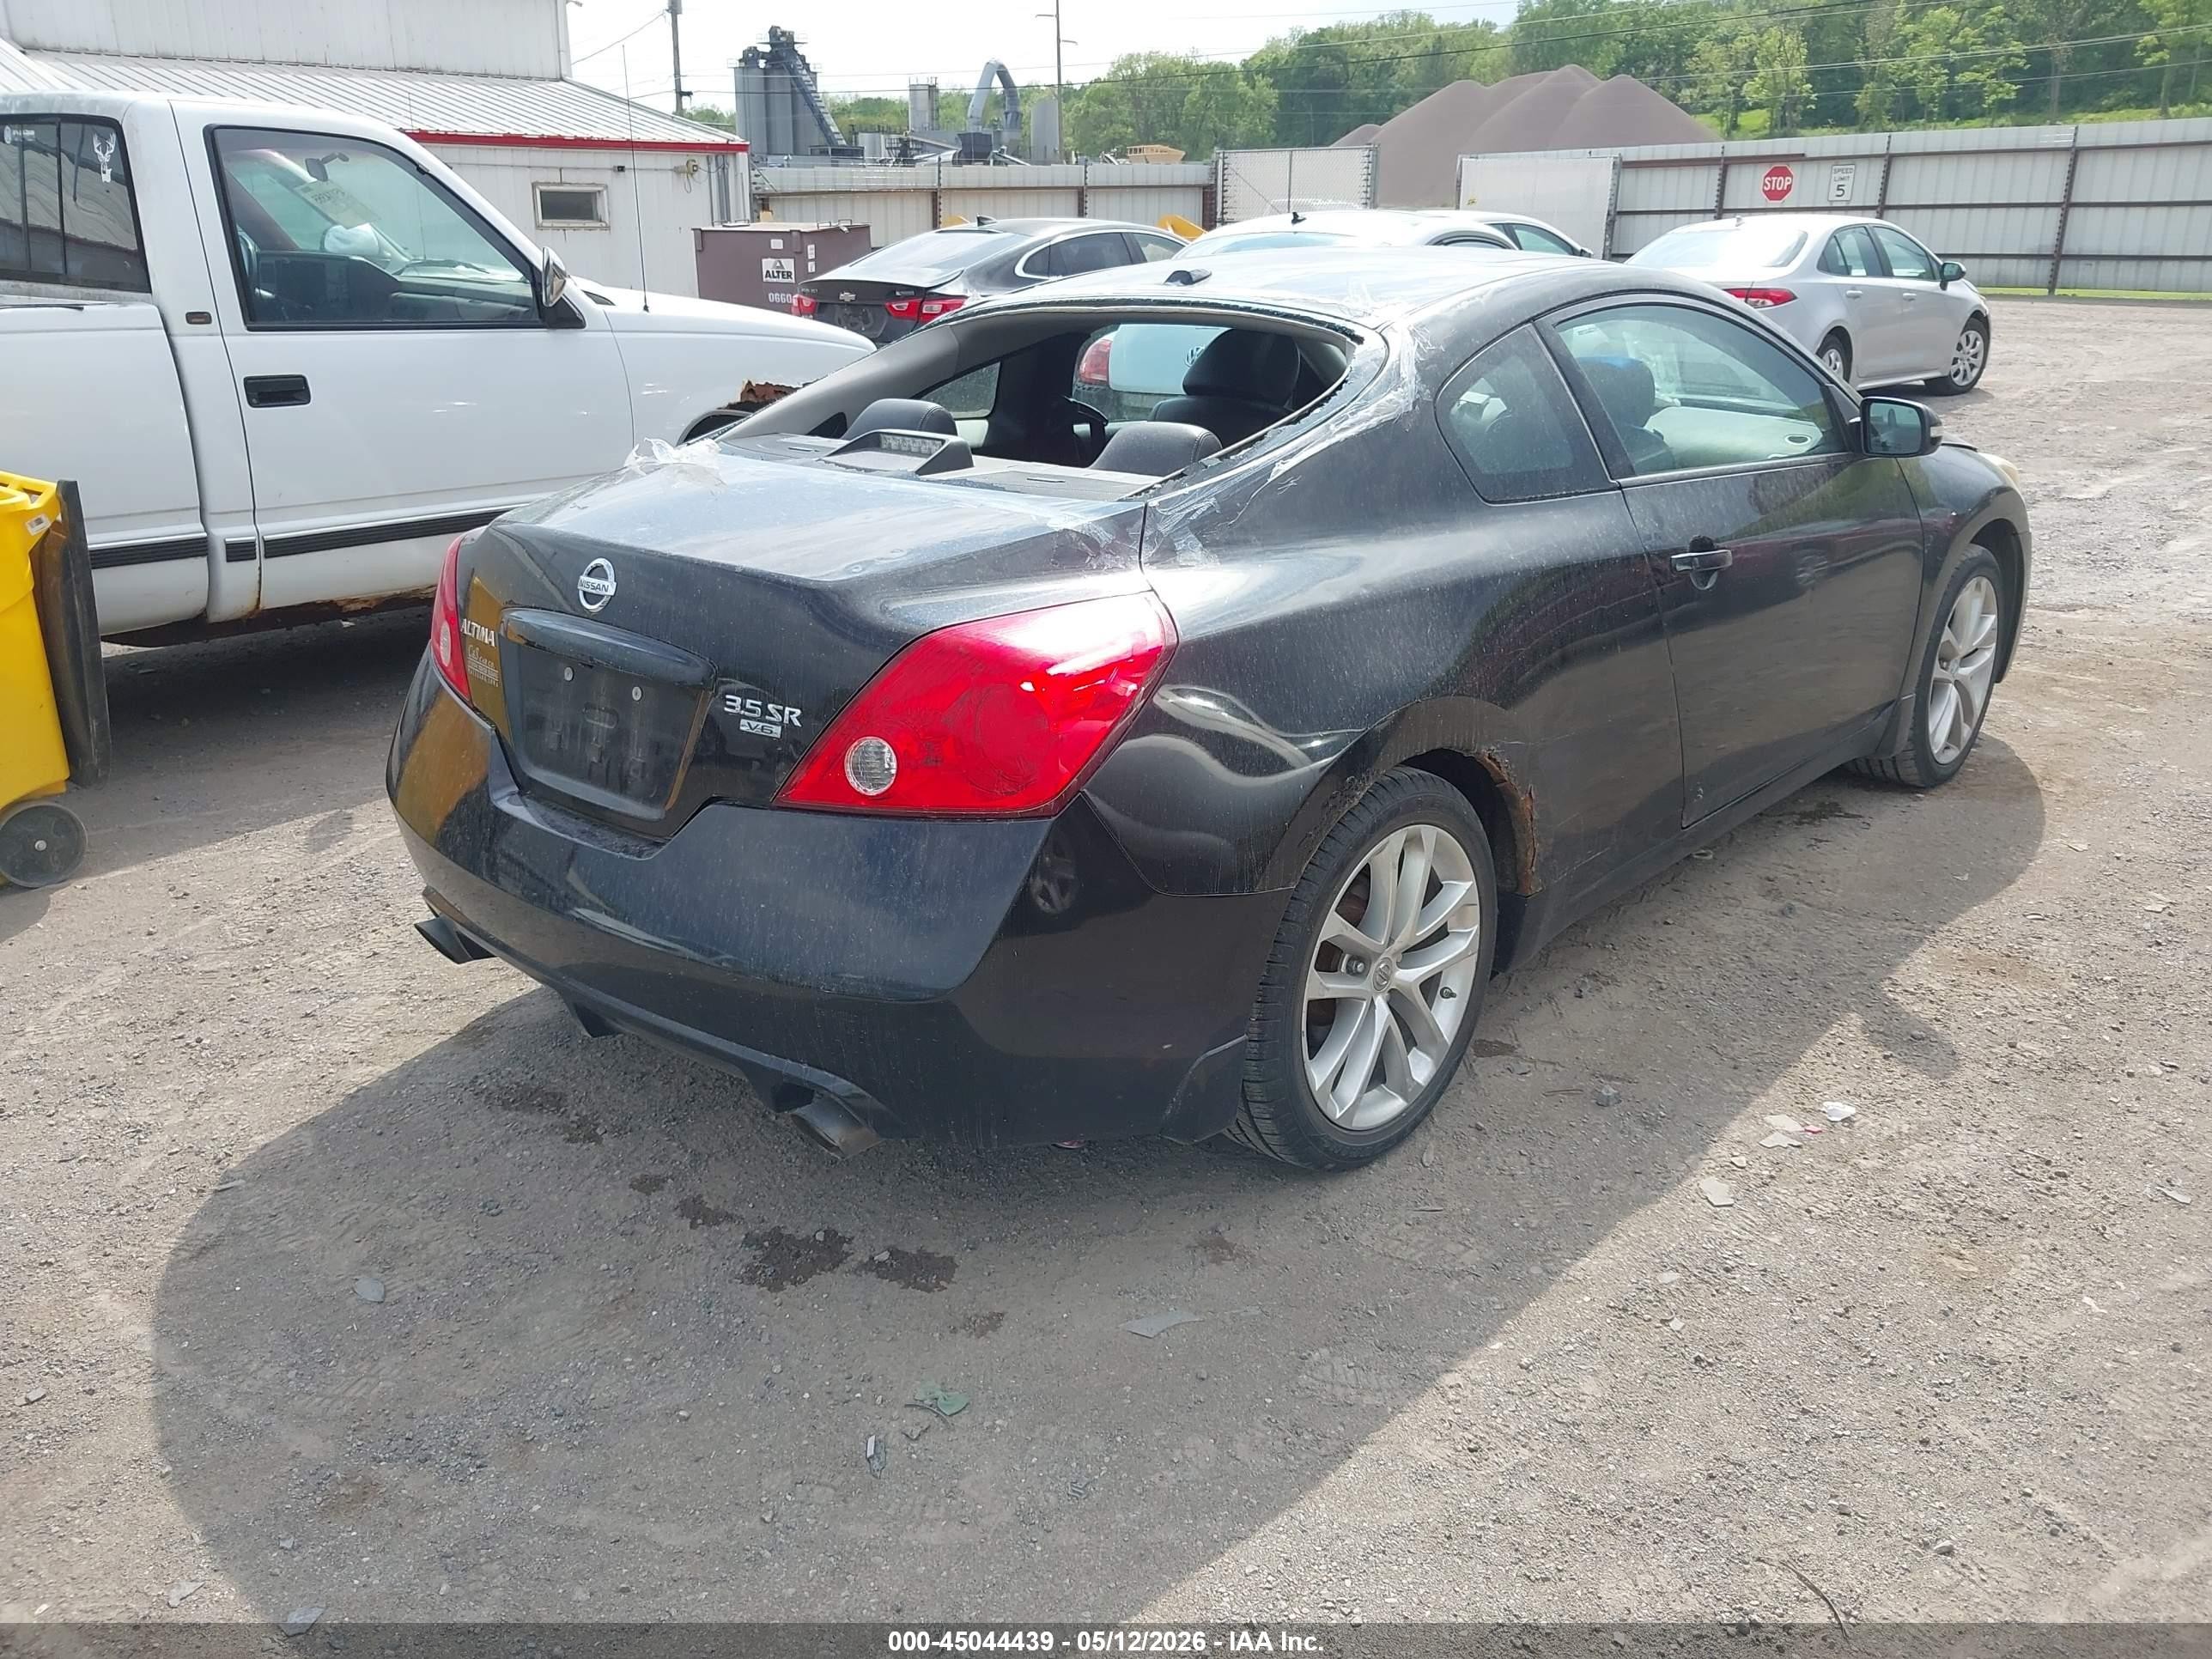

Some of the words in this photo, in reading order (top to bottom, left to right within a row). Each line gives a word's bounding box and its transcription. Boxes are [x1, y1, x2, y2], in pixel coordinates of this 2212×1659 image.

[1763, 176, 1792, 191] STOP
[1835, 184, 1846, 198] 5
[764, 270, 793, 280] ALTER
[768, 292, 793, 304] 0660
[579, 579, 610, 592] NISSAN
[460, 618, 495, 647] ALTIMA
[765, 703, 802, 727] SR
[746, 720, 774, 735] V6
